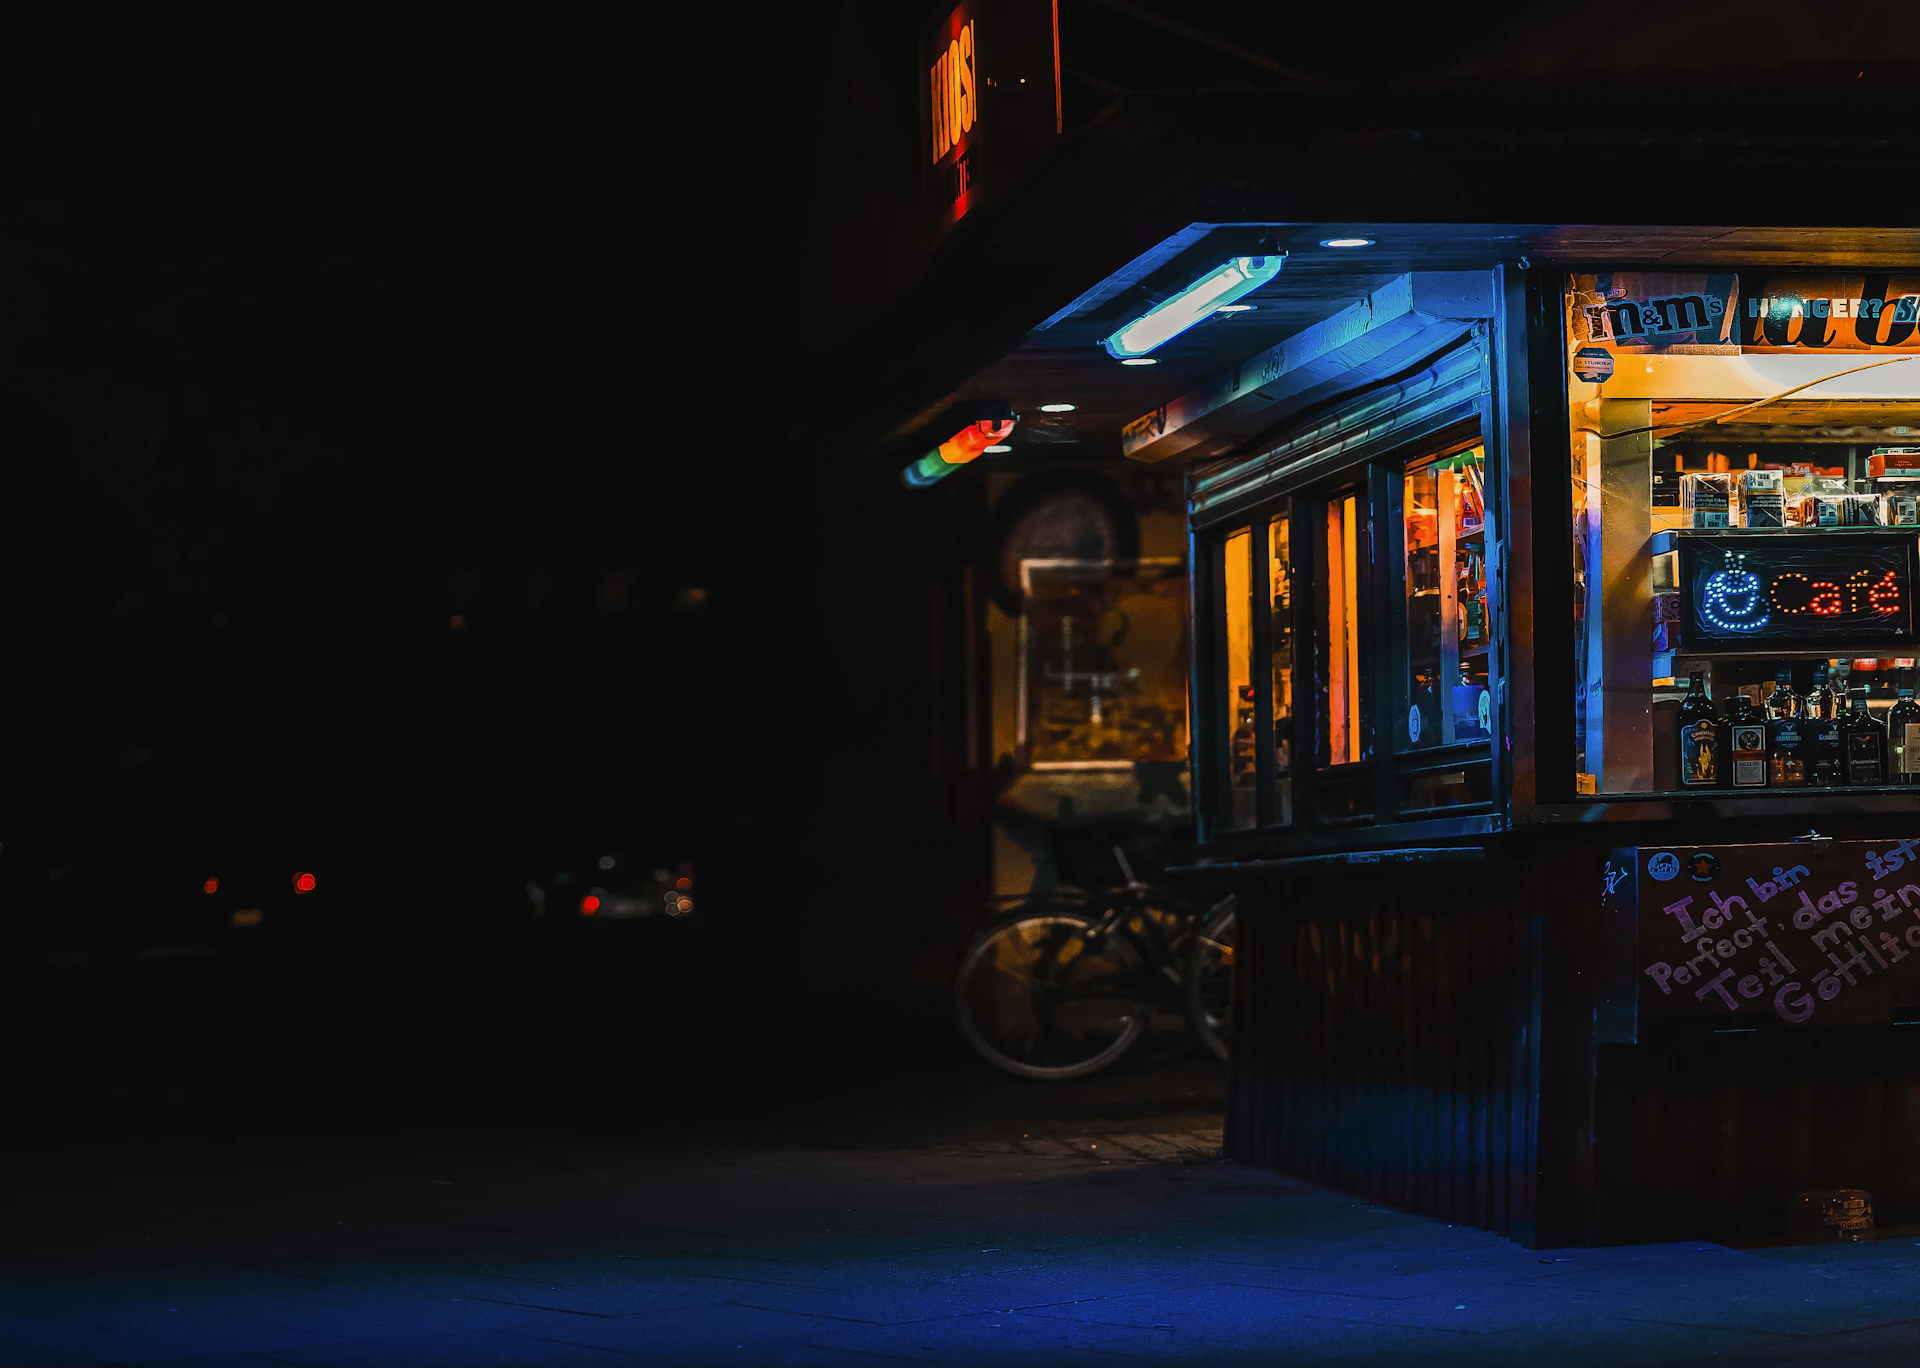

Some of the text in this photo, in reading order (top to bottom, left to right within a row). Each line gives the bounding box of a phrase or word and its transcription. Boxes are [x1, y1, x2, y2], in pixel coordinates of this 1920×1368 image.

[1770, 569, 1901, 615] Café
[1663, 863, 1811, 944] Ich bin
[1793, 881, 1859, 931] das
[1865, 839, 1920, 881] ist
[1695, 940, 1797, 1011] Teil
[1774, 910, 1920, 1023] Göttlic
